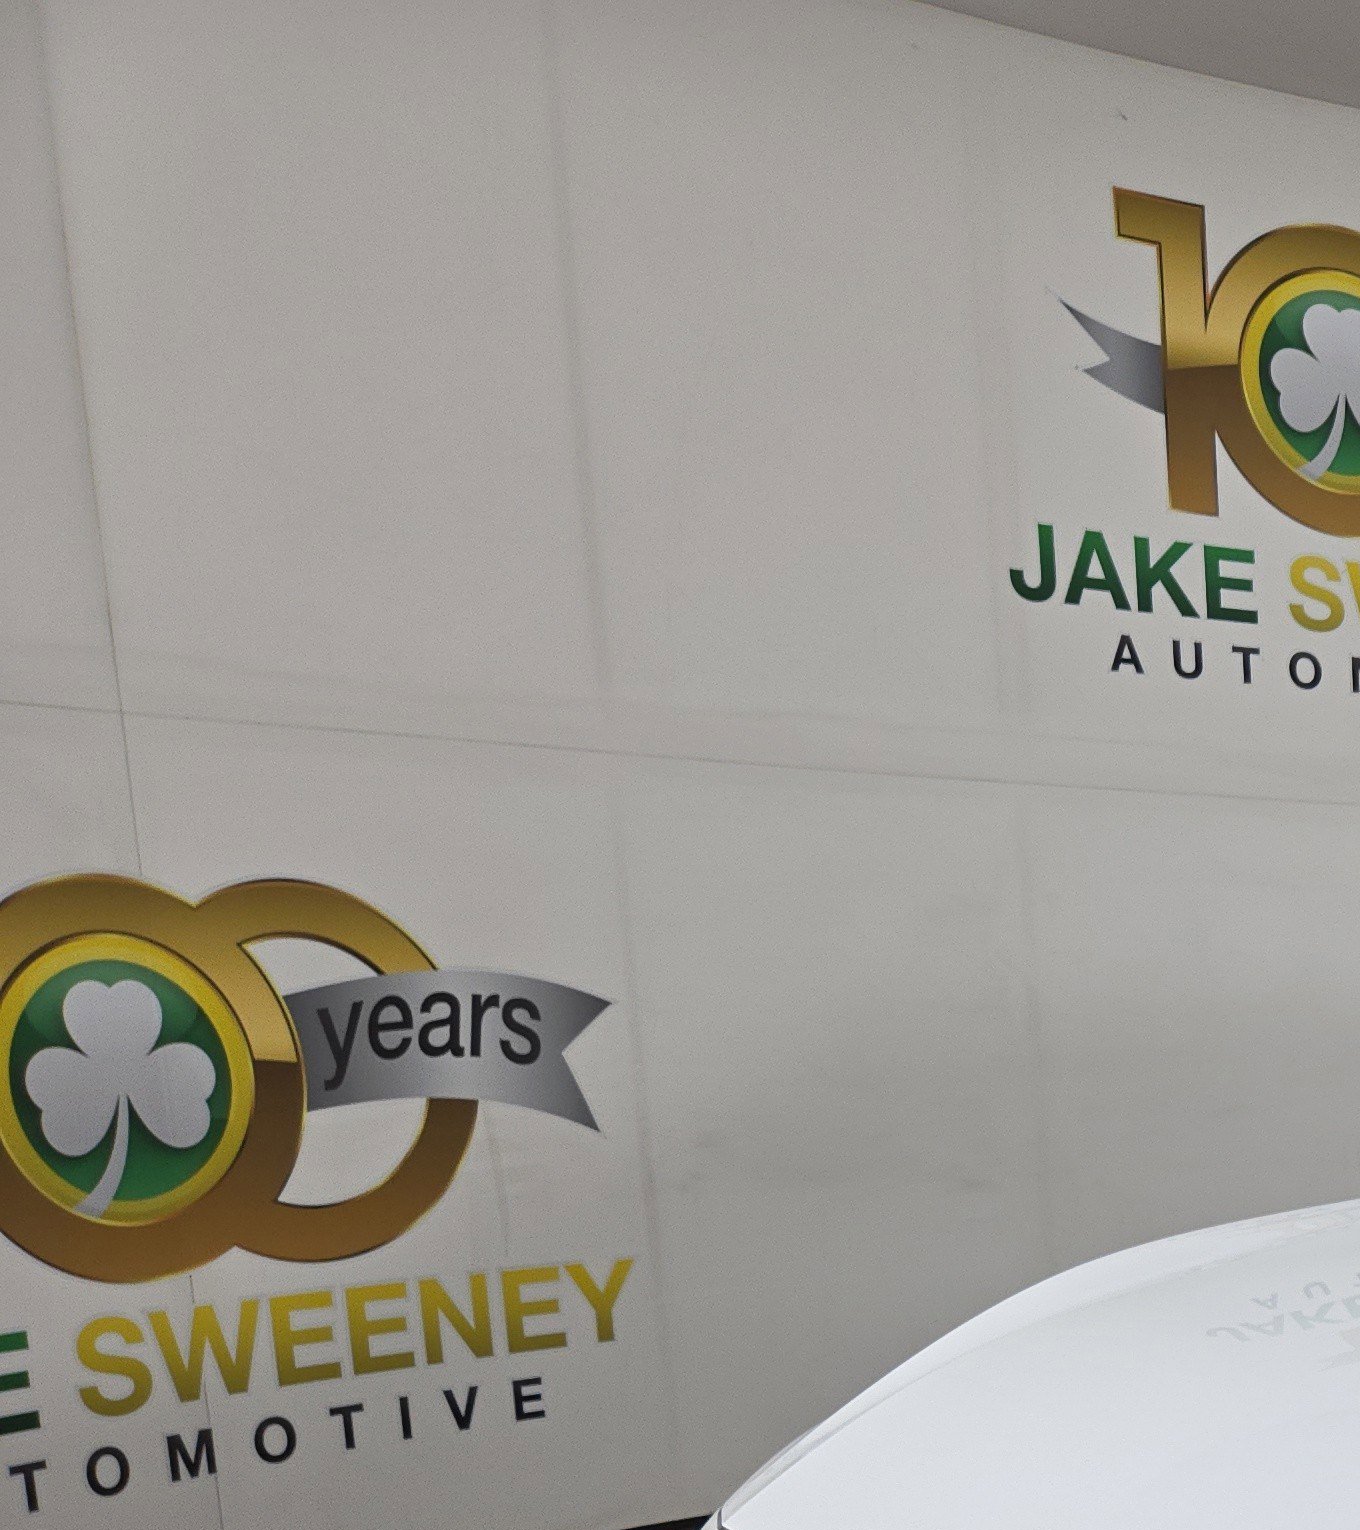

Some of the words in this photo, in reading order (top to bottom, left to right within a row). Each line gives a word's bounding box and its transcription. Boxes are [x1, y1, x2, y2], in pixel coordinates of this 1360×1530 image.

[1009, 524, 1260, 624] JAKE
[757, 808, 844, 871] NISSAN
[315, 991, 542, 1091] years
[75, 1257, 634, 1417] SWEENEY
[9, 1376, 547, 1513] TOMOTIVE
